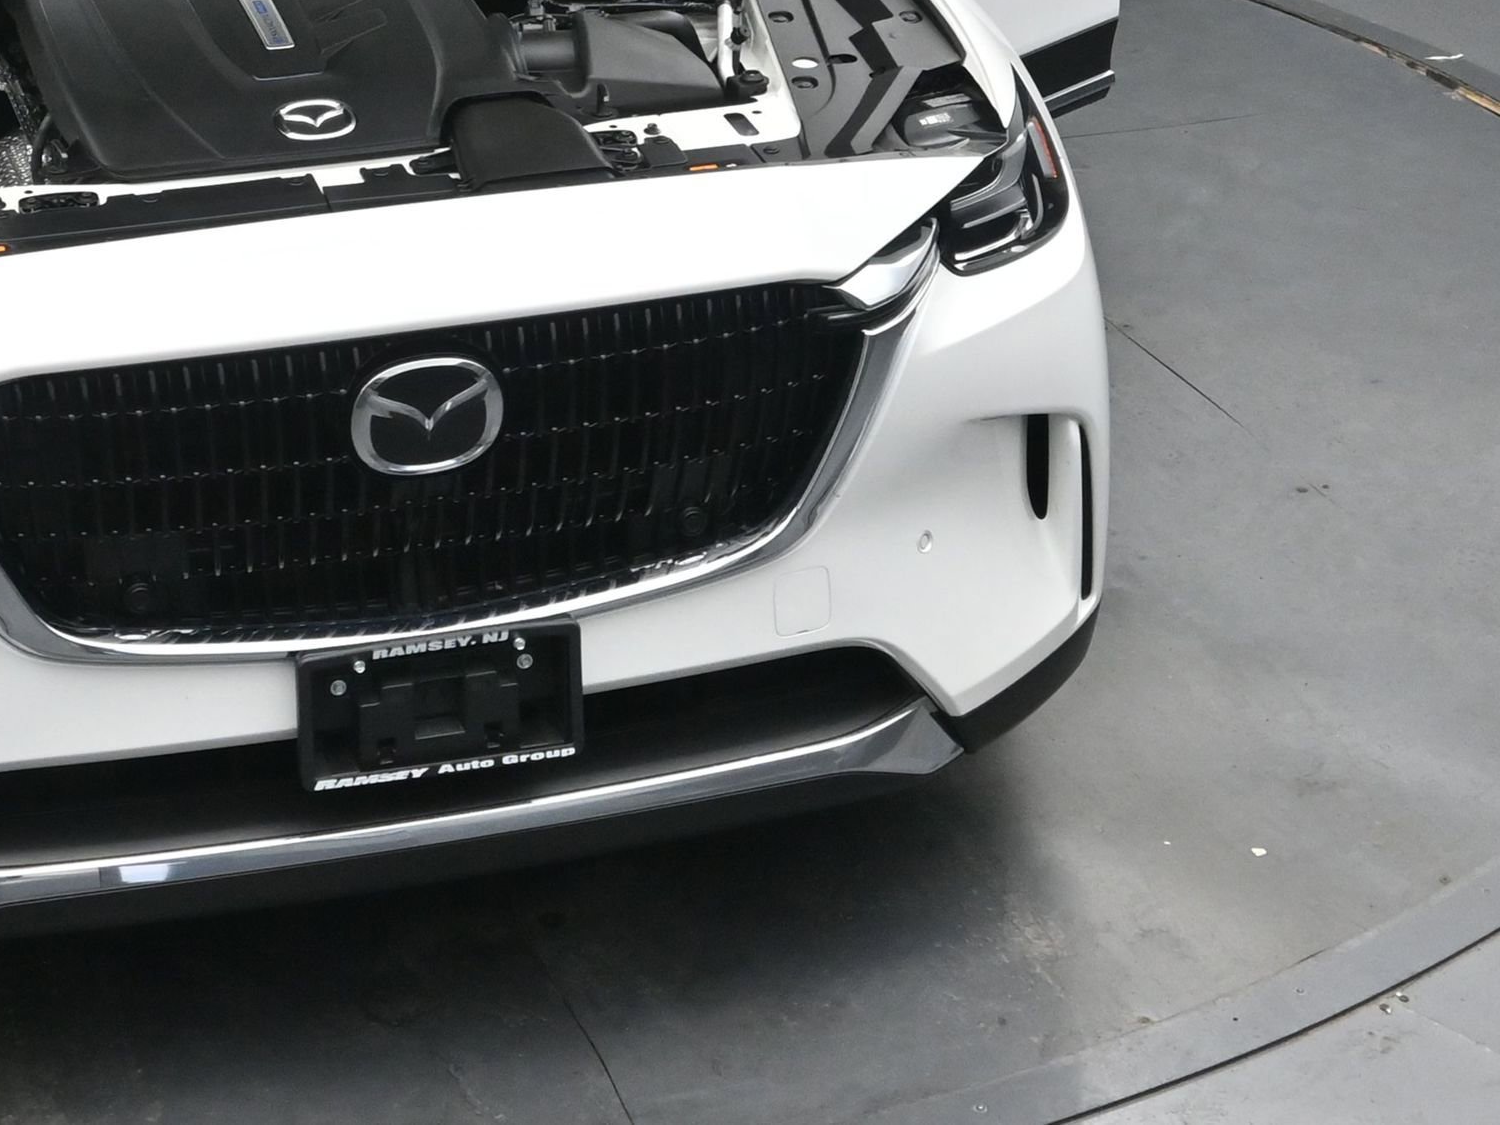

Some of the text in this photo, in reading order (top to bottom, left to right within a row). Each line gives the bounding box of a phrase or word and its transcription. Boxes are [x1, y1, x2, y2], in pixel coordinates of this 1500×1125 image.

[482, 631, 509, 644] NJ
[313, 747, 576, 791] RAMSEY Auto Group
